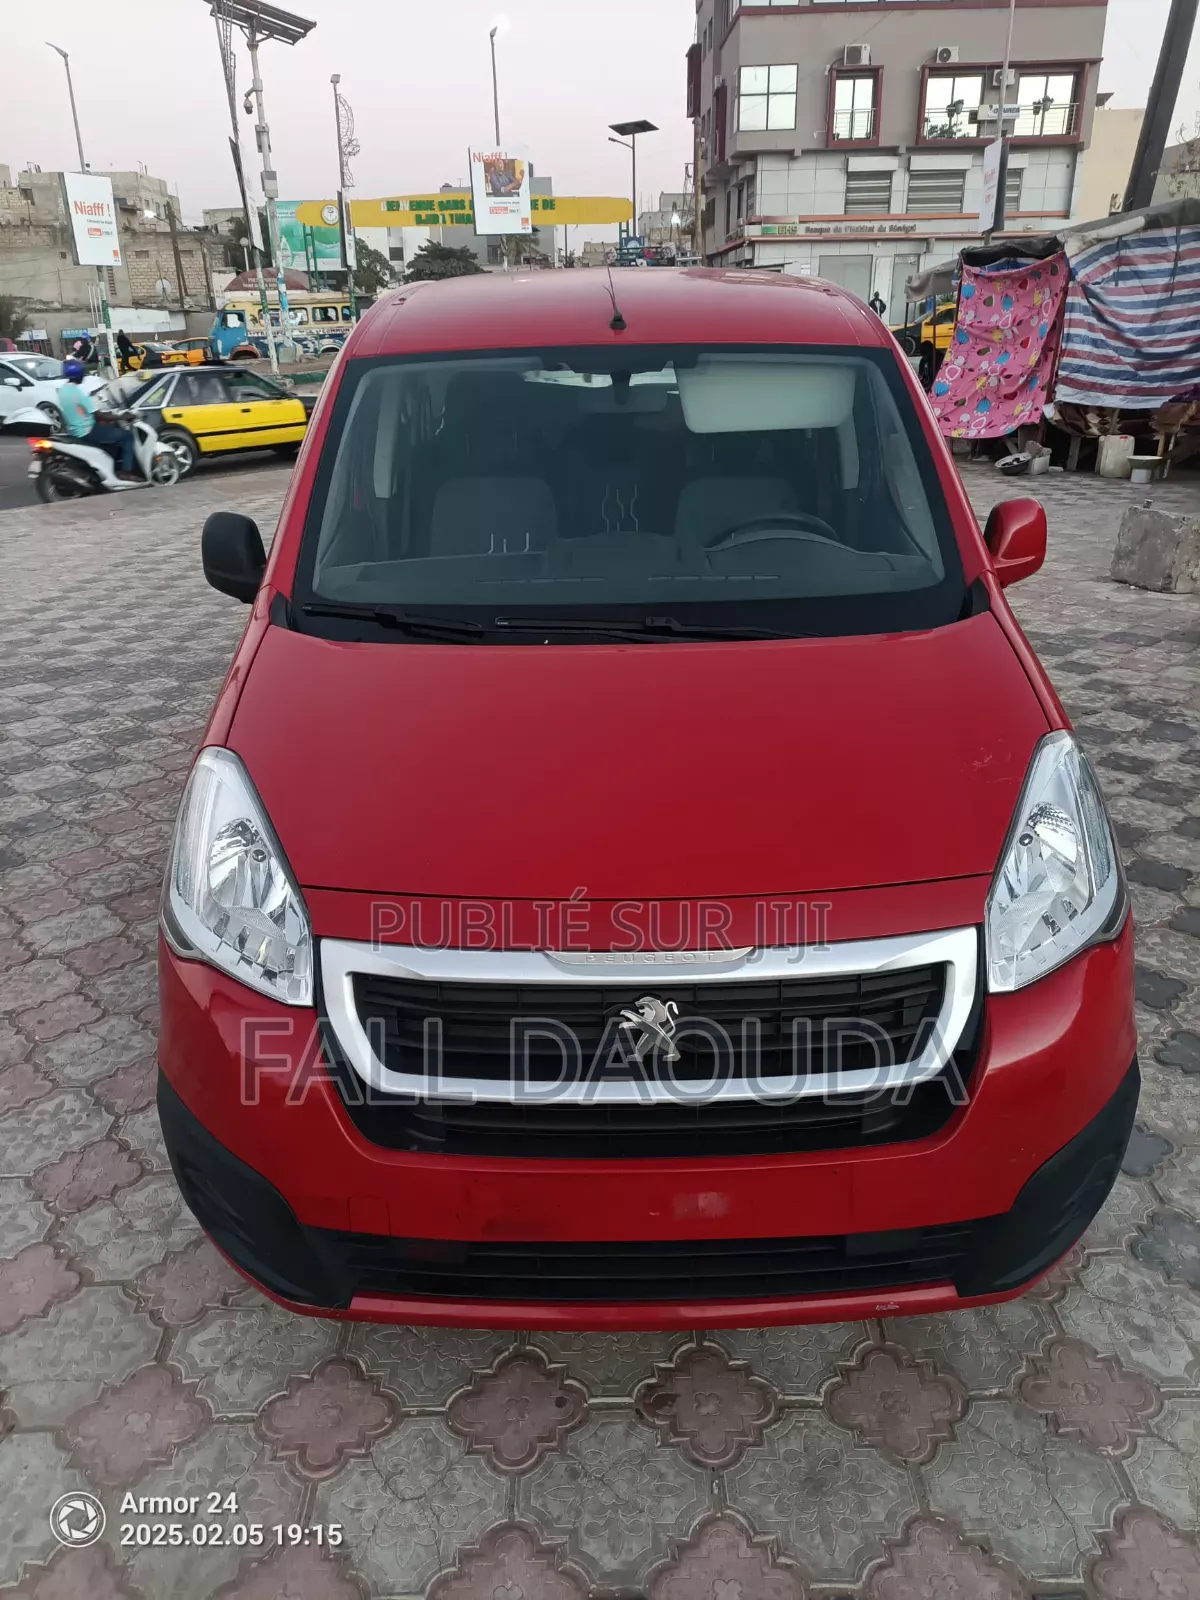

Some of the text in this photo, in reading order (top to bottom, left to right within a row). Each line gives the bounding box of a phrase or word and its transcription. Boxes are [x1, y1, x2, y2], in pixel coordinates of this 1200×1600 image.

[473, 151, 503, 163] Niafff
[73, 200, 104, 216] Niafff
[584, 952, 715, 964] PEUGEOT
